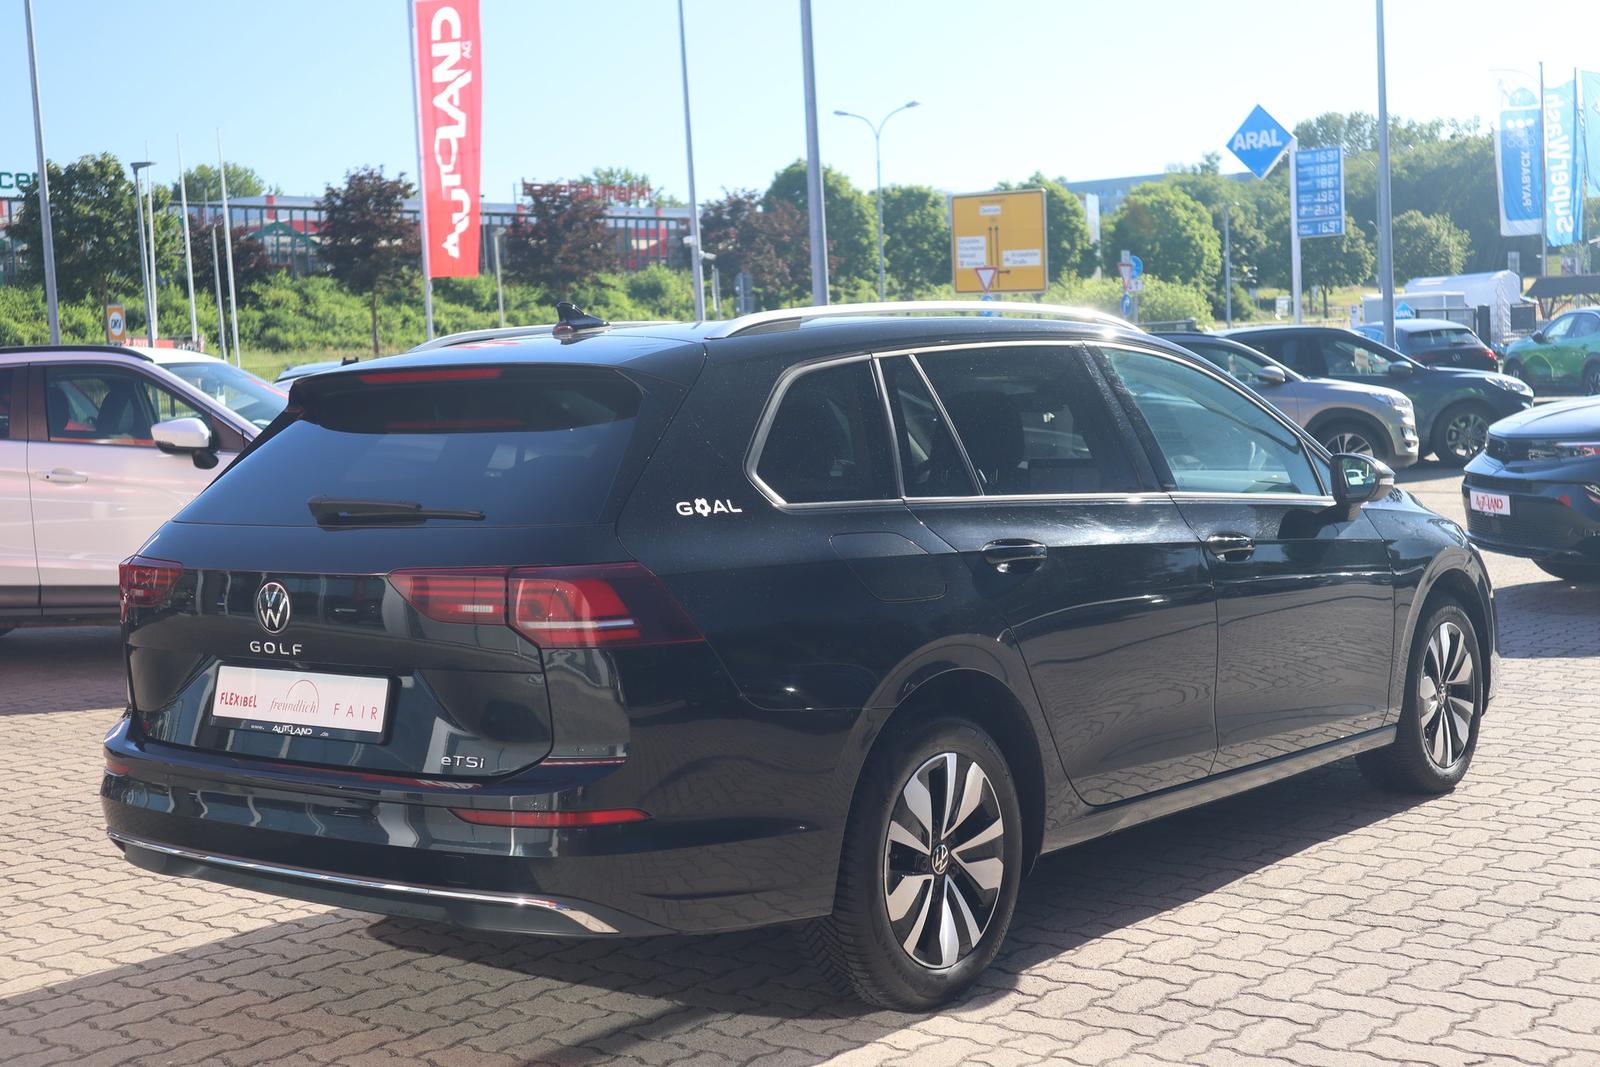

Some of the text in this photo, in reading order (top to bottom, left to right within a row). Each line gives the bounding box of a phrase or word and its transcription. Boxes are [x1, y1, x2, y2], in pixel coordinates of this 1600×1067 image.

[461, 41, 472, 59] AG
[431, 6, 472, 259] AUTOLAND
[1233, 129, 1282, 152] ARAL
[676, 498, 743, 517] GOAL
[249, 641, 302, 655] GOLF
[219, 692, 378, 720] FLEXIBEL freundlich FAIR
[272, 724, 313, 736] AUTOLAND
